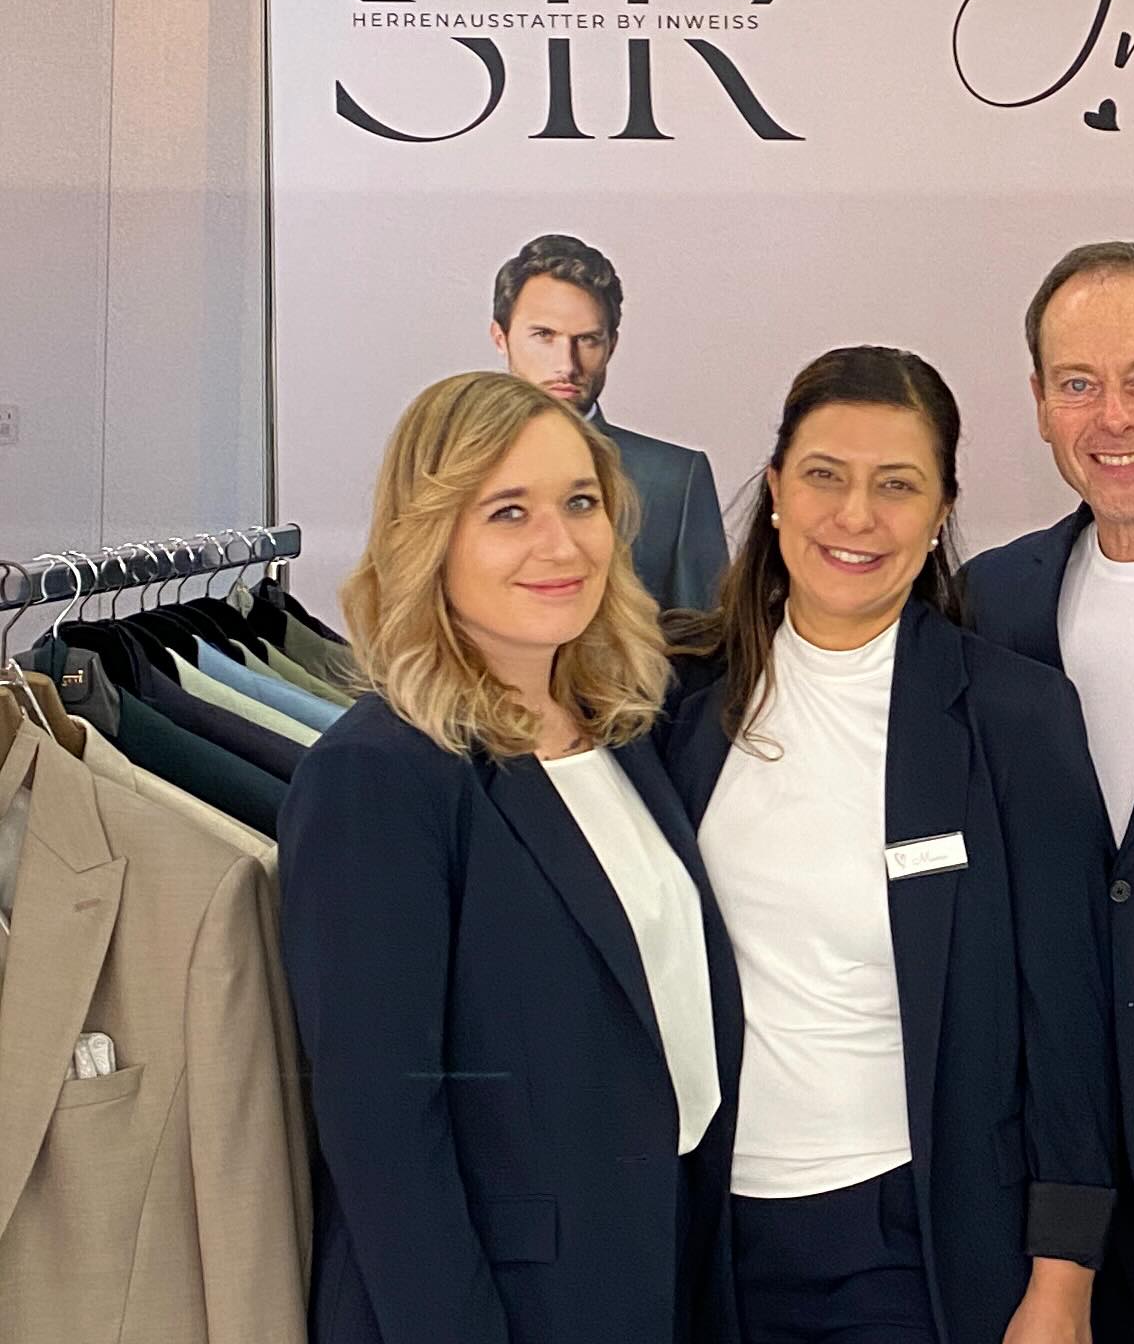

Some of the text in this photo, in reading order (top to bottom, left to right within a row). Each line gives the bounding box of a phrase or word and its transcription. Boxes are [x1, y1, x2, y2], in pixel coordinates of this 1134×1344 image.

[352, 12, 760, 32] HERRENAUSSTATTER BY INWEISS
